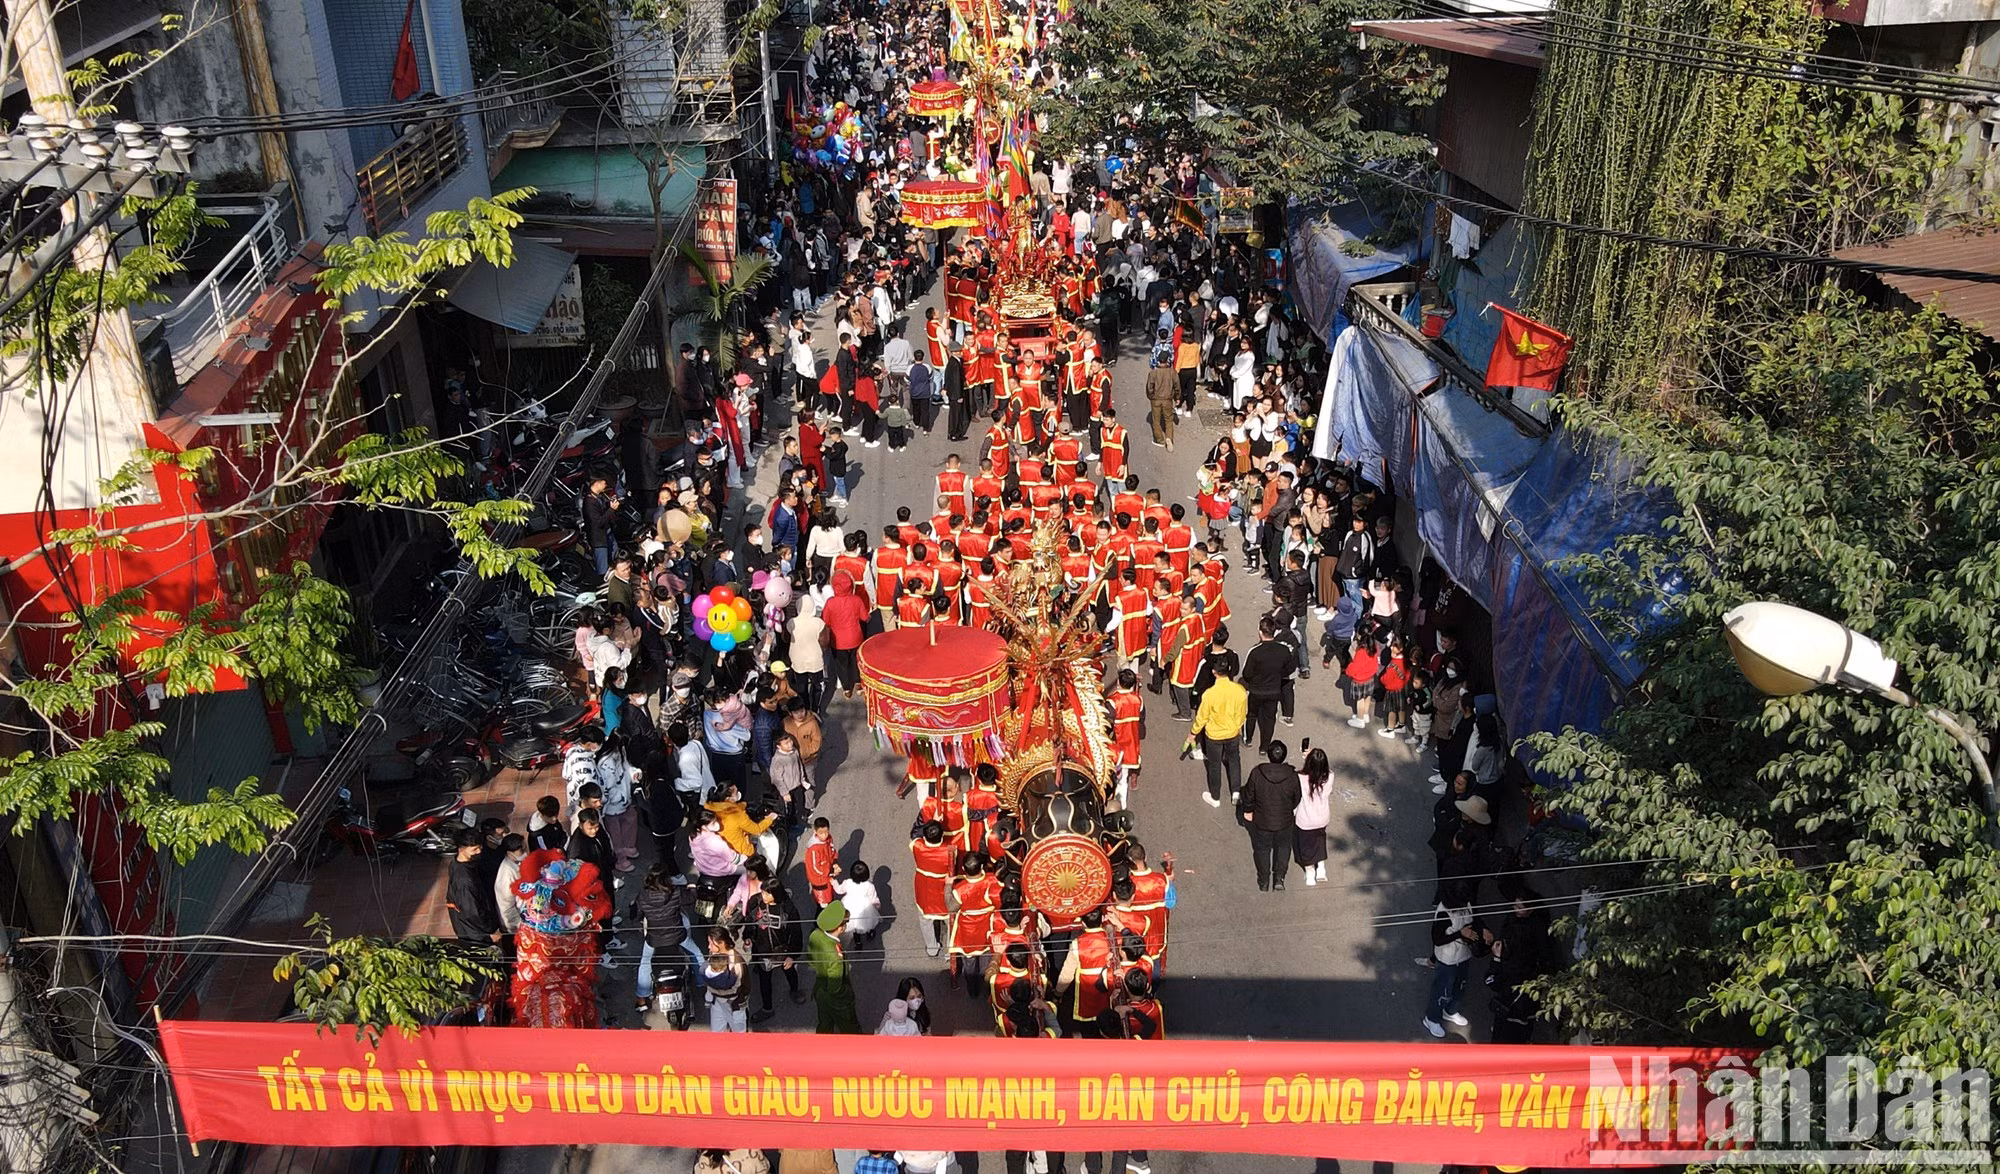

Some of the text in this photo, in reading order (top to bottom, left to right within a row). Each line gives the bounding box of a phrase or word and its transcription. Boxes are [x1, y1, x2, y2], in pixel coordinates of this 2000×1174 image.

[257, 1050, 328, 1111] TẤT
[337, 1052, 394, 1112] CẢ
[397, 1059, 439, 1112] VÌ
[445, 1070, 533, 1123] MỤC
[540, 1063, 624, 1114] TIÊU
[633, 1064, 713, 1115] DÂN
[723, 1066, 822, 1123] GIÀU,
[832, 1069, 933, 1119] NƯỚC
[945, 1076, 1066, 1129] MẠNH,
[1079, 1072, 1156, 1121] DÂN
[1167, 1068, 1249, 1128] CHỦ,
[1263, 1072, 1365, 1124] CÔNG
[1373, 1066, 1485, 1134] BẰNG,
[1499, 1072, 1576, 1129] VĂN
